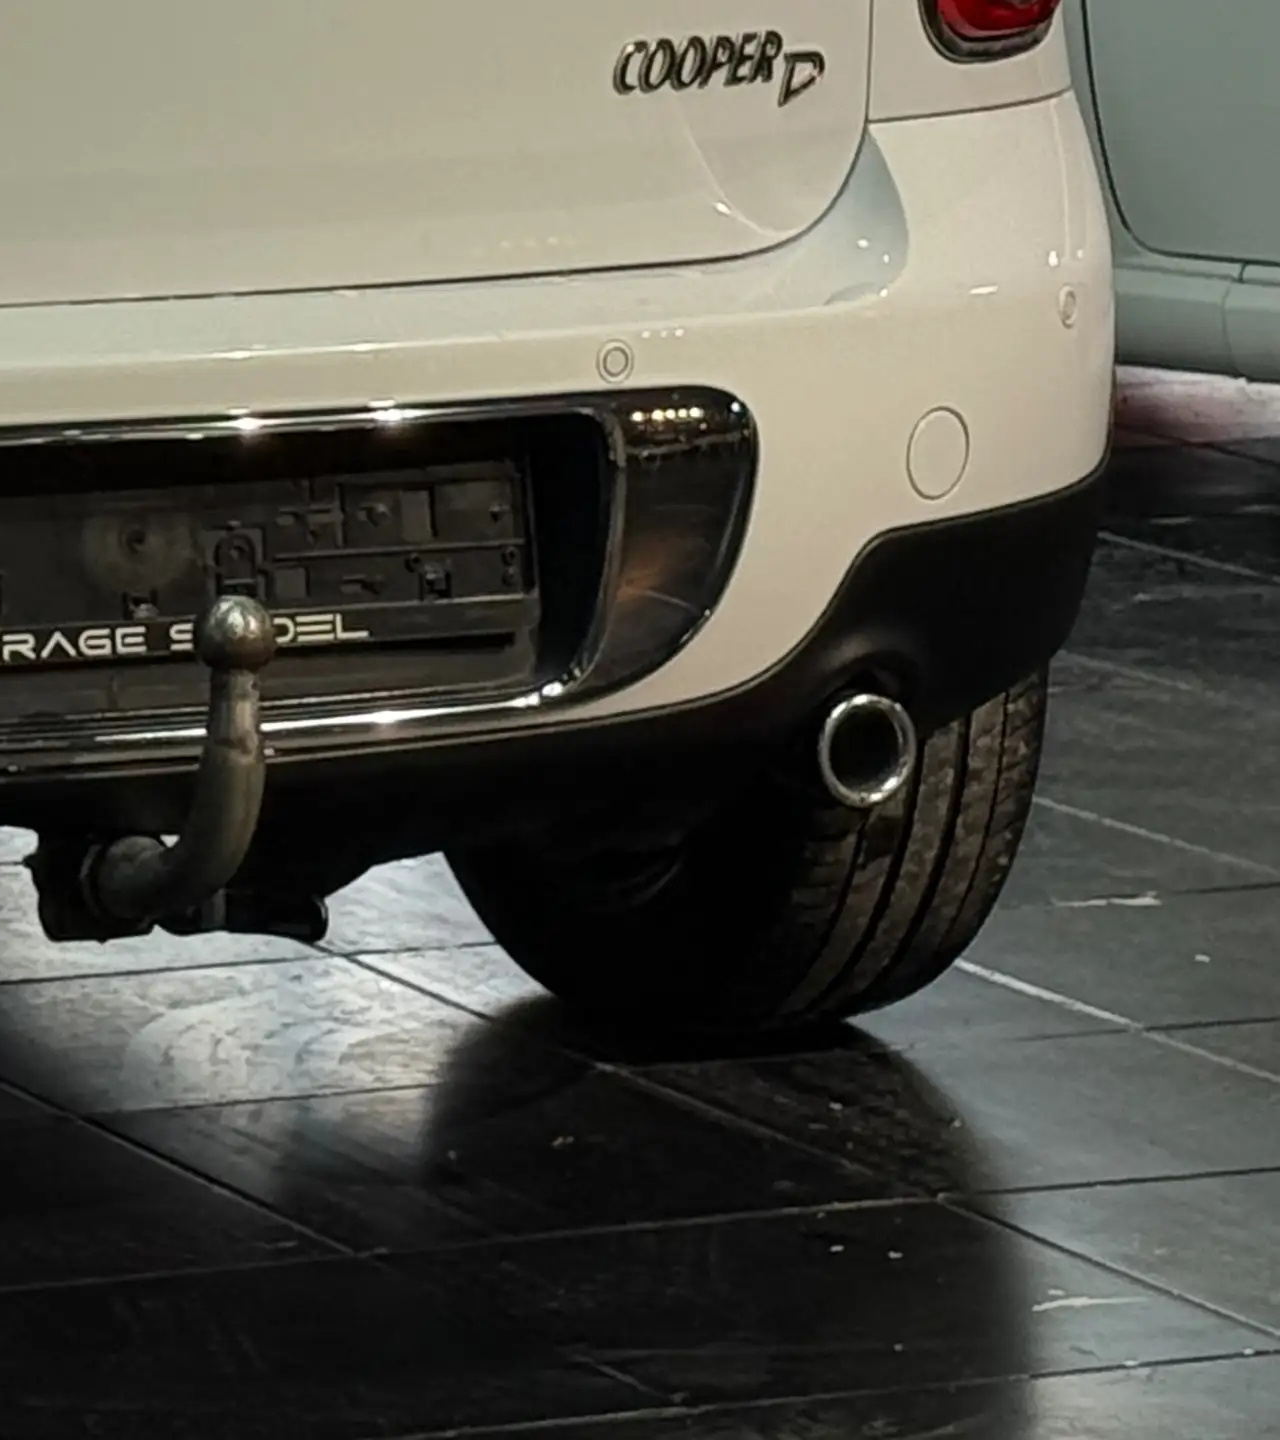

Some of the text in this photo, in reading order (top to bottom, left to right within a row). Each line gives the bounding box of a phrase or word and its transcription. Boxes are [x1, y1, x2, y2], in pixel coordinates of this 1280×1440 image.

[612, 30, 826, 108] COOPER D
[169, 613, 370, 652] SDEL
